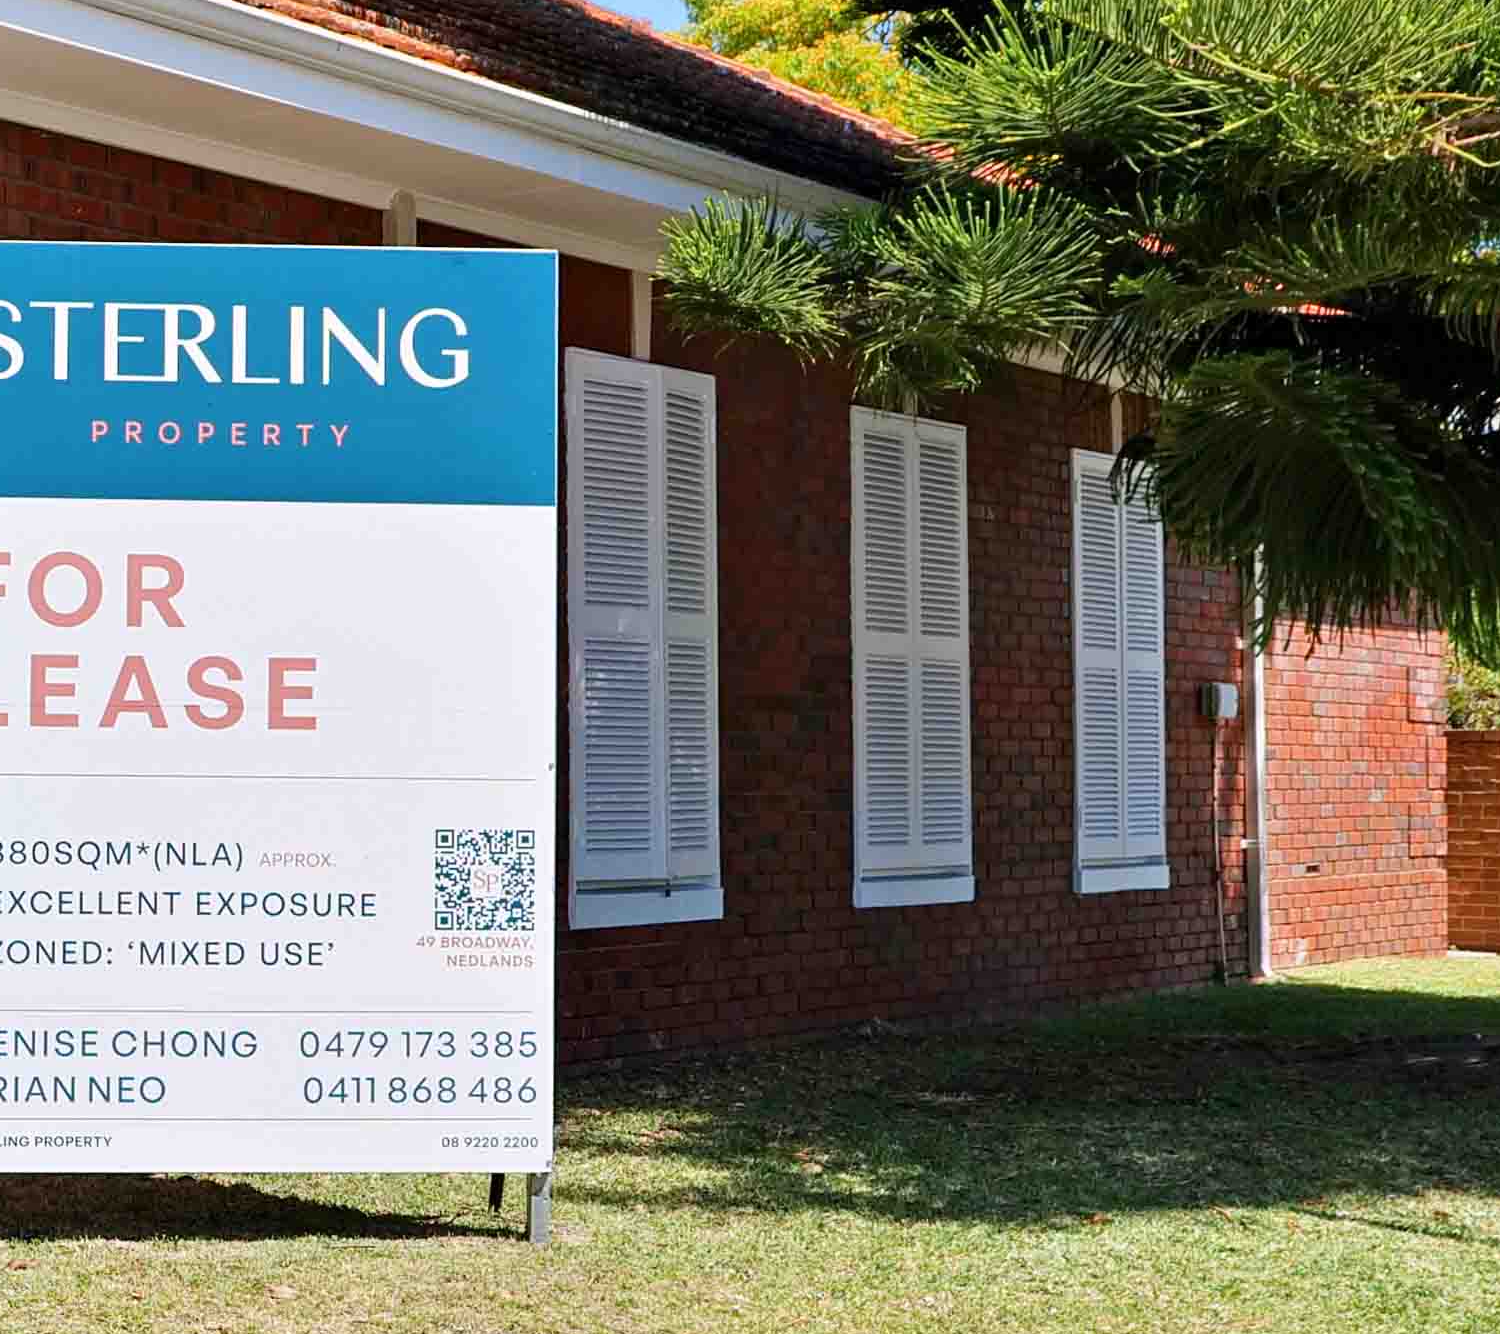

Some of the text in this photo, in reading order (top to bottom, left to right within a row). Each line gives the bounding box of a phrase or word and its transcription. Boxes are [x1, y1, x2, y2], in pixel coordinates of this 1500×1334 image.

[91, 420, 350, 447] PROPERTY
[196, 892, 377, 917] EXPOSURE
[416, 937, 436, 948] 49
[446, 954, 534, 968] NEDLANDS
[112, 1030, 257, 1058] CHONG
[300, 1031, 389, 1058] 0479
[401, 1031, 456, 1058] 173
[470, 1031, 537, 1058] 385
[88, 1076, 166, 1103] NEO
[304, 1077, 375, 1104] 0411
[388, 1077, 456, 1104] 868
[468, 1077, 537, 1104] 486
[34, 1136, 112, 1148] PROPERTY
[441, 1137, 459, 1148] 08
[464, 1137, 499, 1148] 9220
[503, 1137, 538, 1148] 2200
